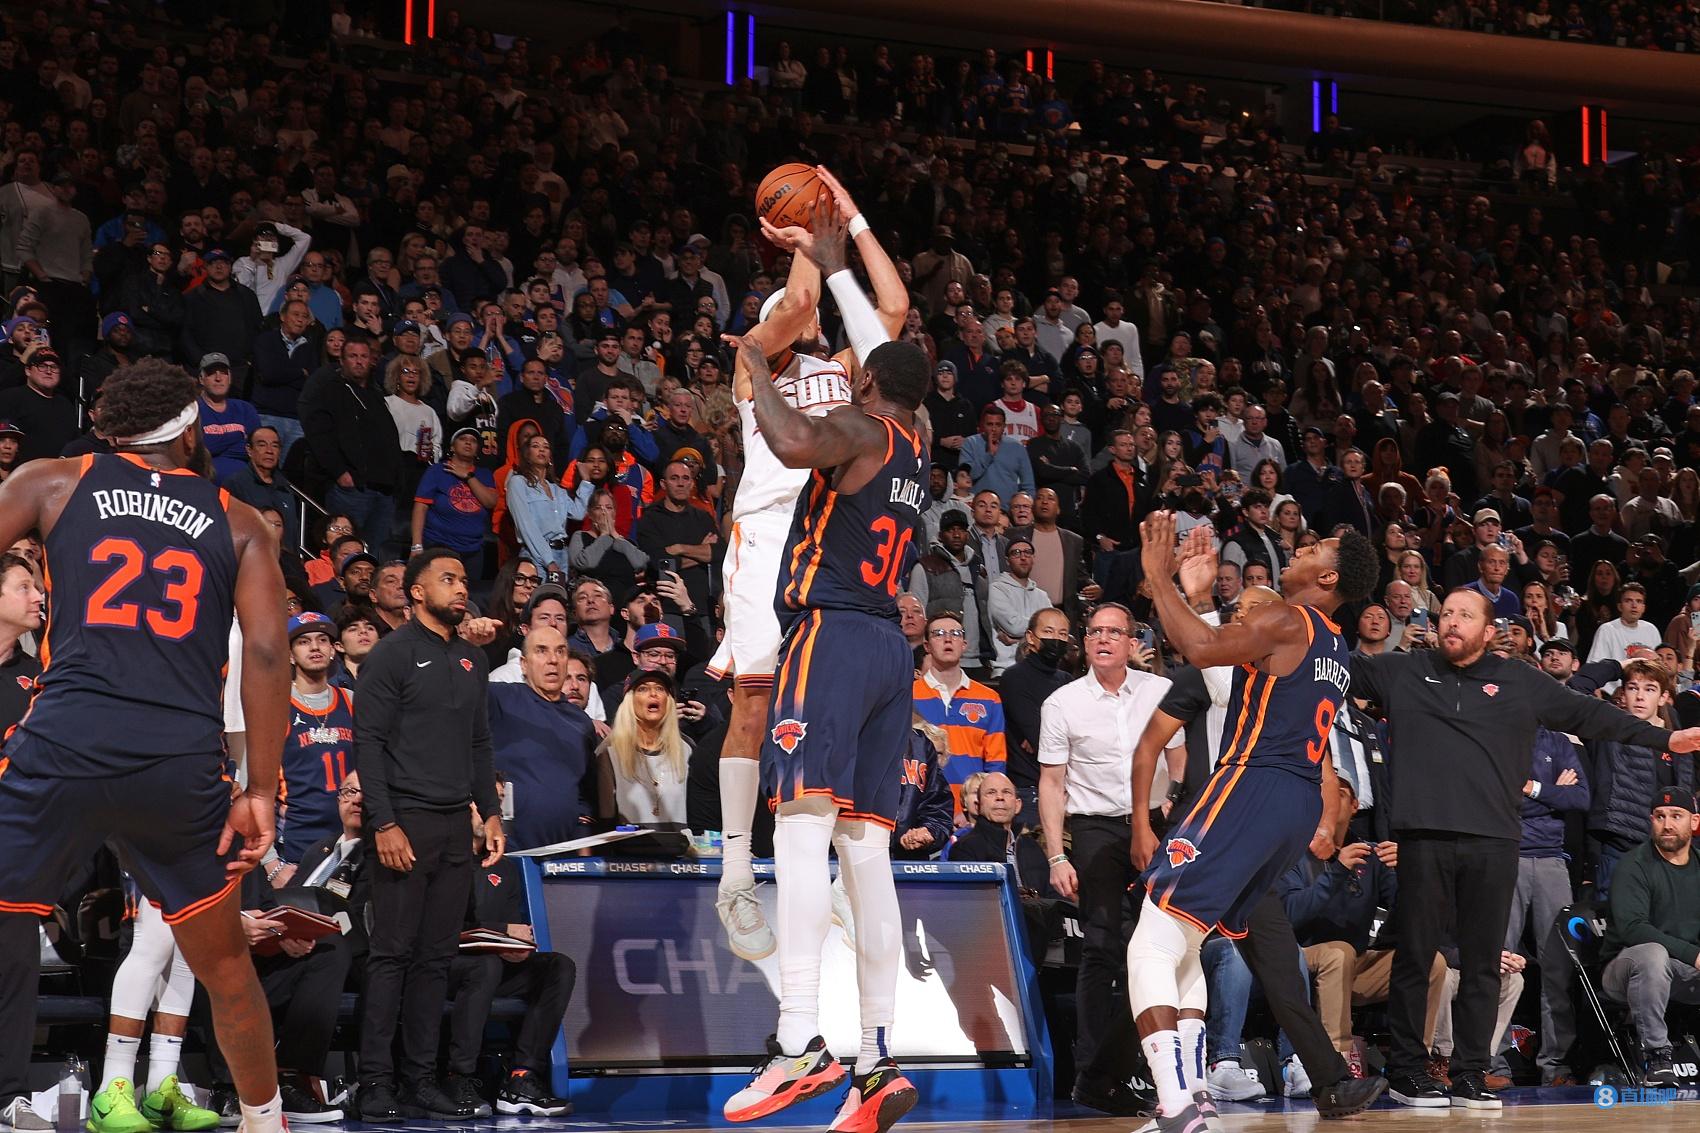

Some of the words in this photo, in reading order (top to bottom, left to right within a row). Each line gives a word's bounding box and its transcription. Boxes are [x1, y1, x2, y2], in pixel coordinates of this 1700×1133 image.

[92, 489, 214, 539] ROBINSON
[859, 514, 913, 598] 30
[82, 536, 206, 642] 23
[1306, 698, 1335, 765] 9
[322, 751, 348, 791] 11
[546, 862, 585, 874] CHASE
[609, 862, 647, 873] CHASE
[670, 863, 707, 874] CHASE
[903, 864, 939, 874] CHASE
[959, 864, 993, 874] CHASE
[612, 938, 772, 995] CHA
